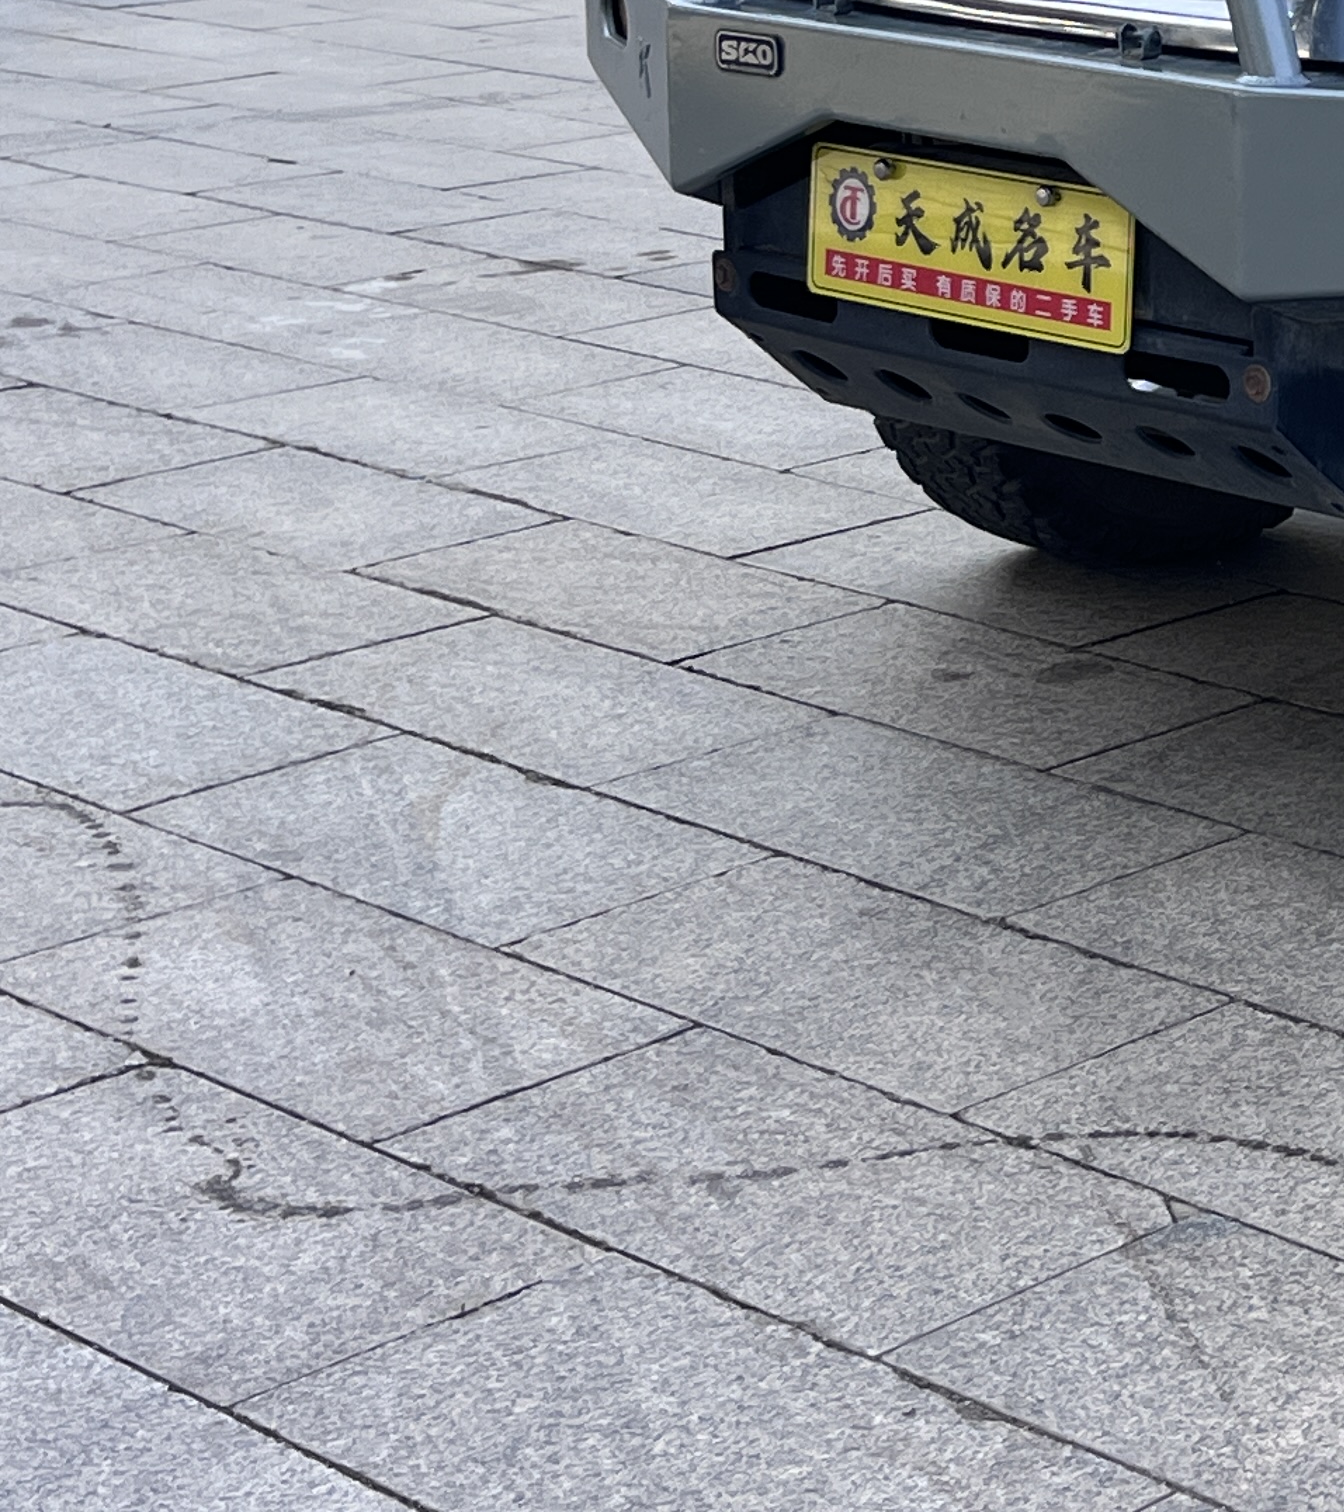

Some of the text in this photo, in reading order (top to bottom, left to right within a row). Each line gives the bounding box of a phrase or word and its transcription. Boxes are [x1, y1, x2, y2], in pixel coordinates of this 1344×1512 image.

[894, 189, 1112, 294] 天成名车
[830, 253, 1105, 329] 先开后买 有质保的二手车
